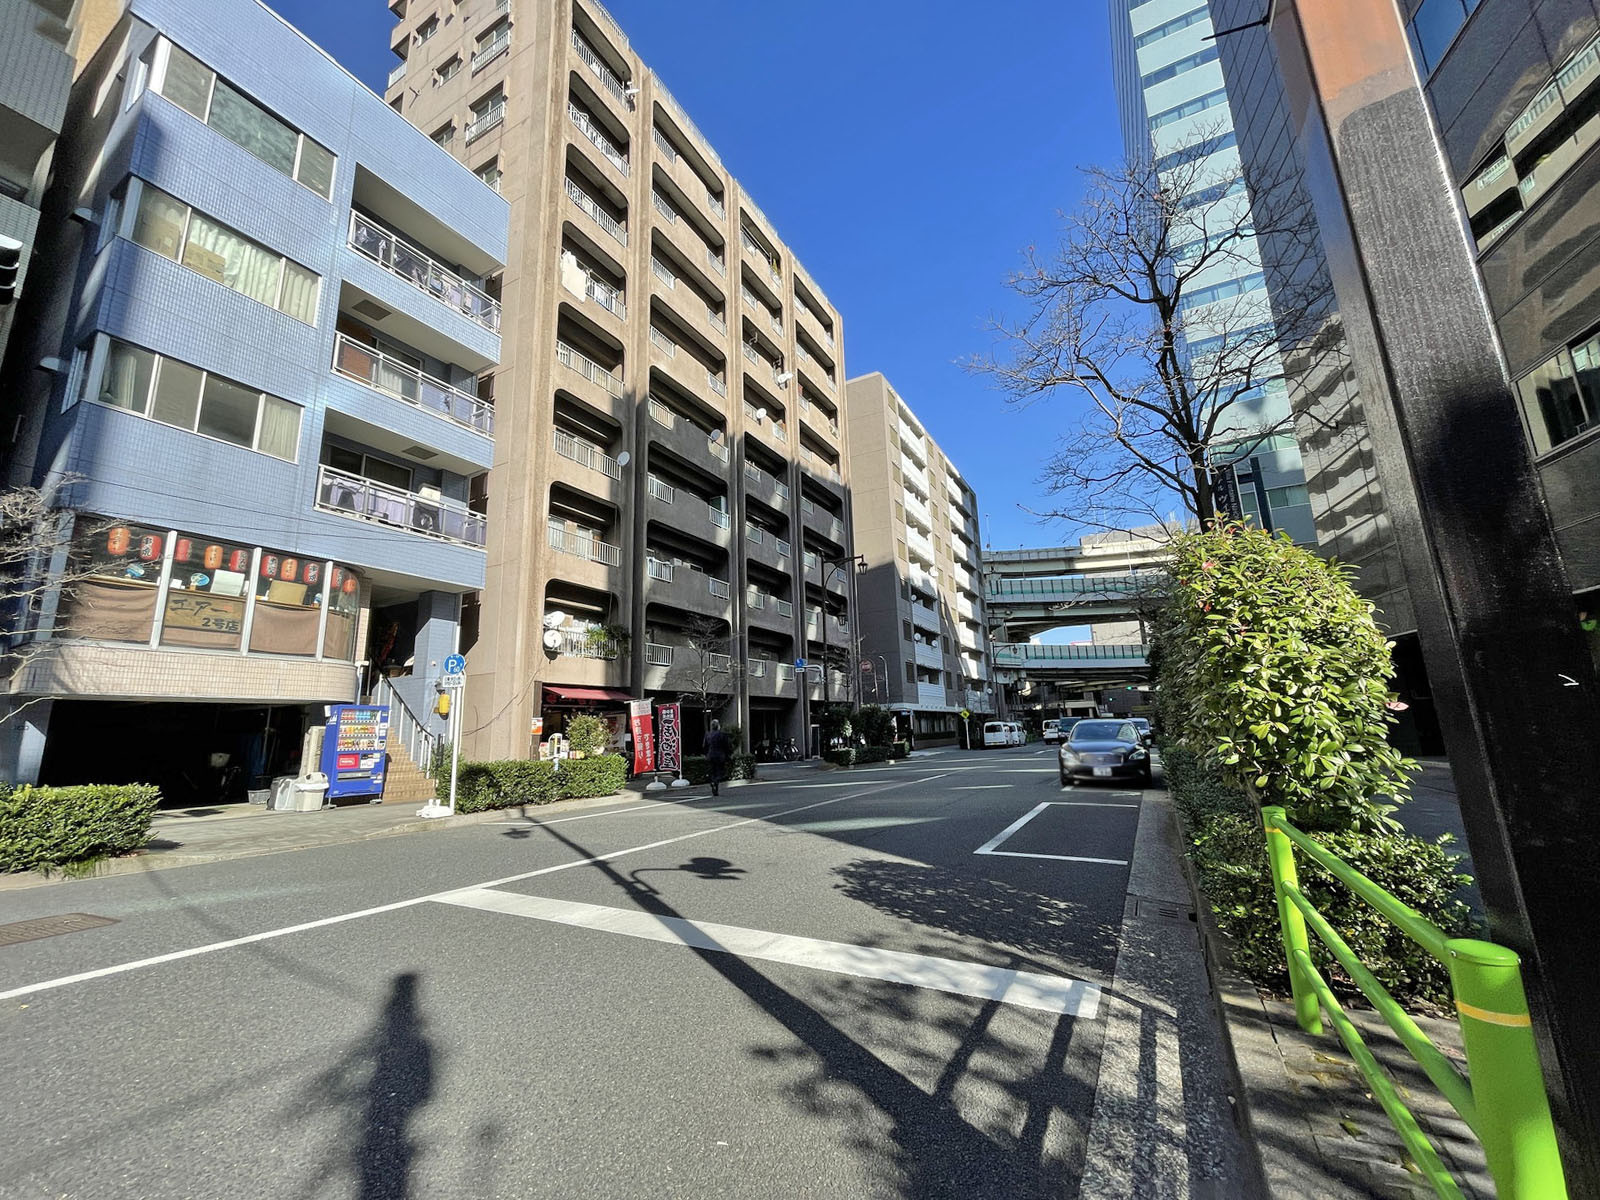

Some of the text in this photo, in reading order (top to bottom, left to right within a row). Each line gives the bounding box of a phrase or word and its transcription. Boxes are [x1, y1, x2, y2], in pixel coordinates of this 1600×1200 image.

[170, 599, 228, 615] エアー
[202, 617, 240, 631] 2号店
[448, 659, 457, 673] P
